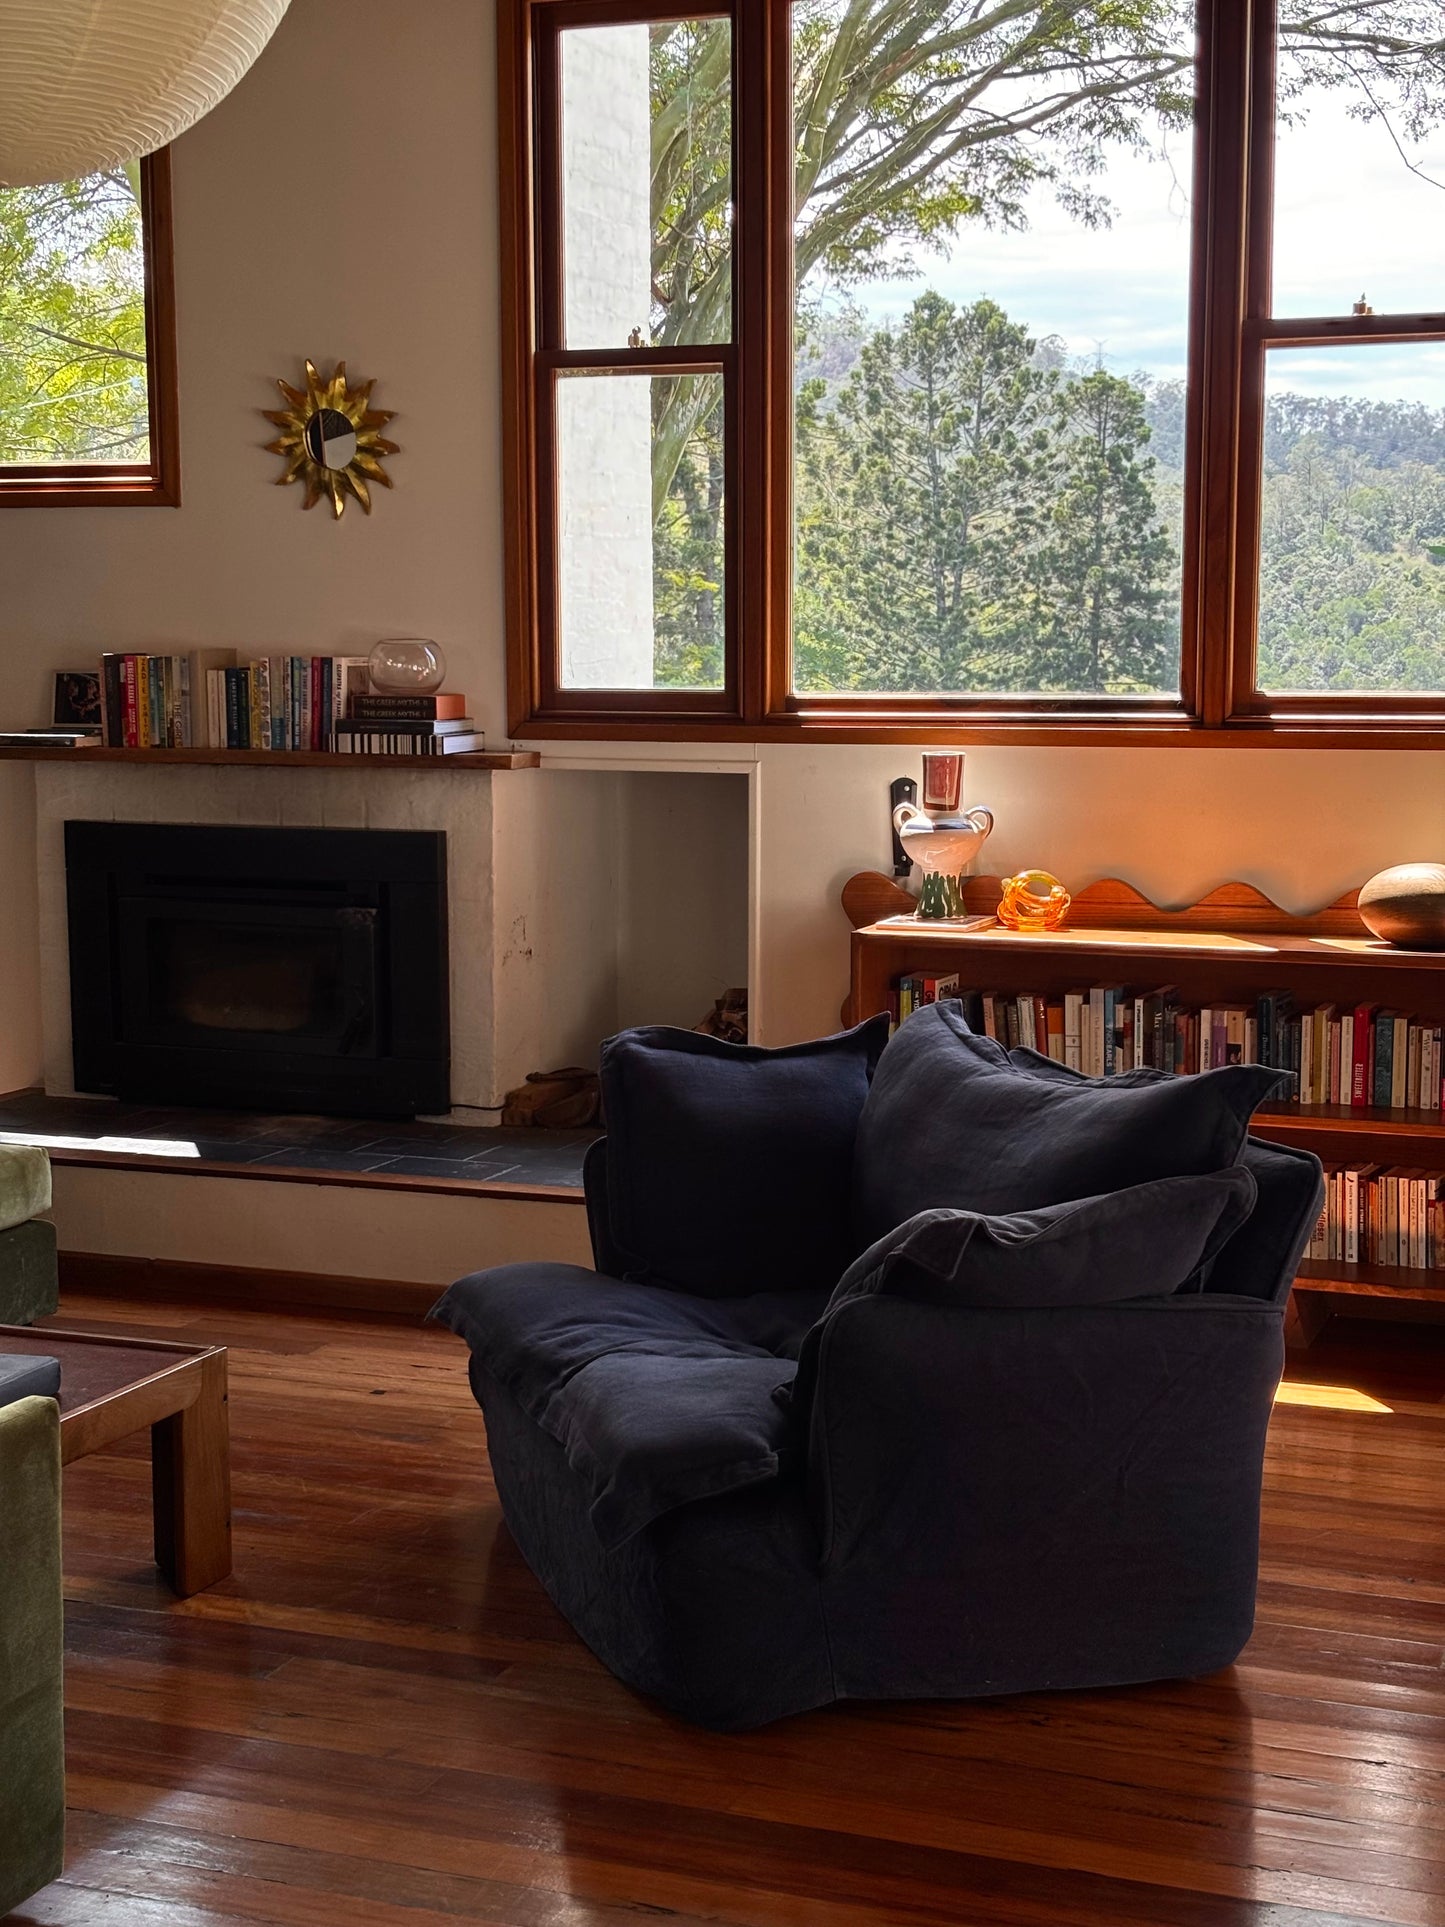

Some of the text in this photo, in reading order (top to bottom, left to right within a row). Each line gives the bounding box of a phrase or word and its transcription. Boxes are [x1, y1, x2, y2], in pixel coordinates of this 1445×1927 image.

[361, 698, 376, 706] THE
[376, 698, 396, 706] GREEK
[1153, 1011, 1163, 1029] Max
[1354, 1063, 1364, 1098] SWEETBITTER
